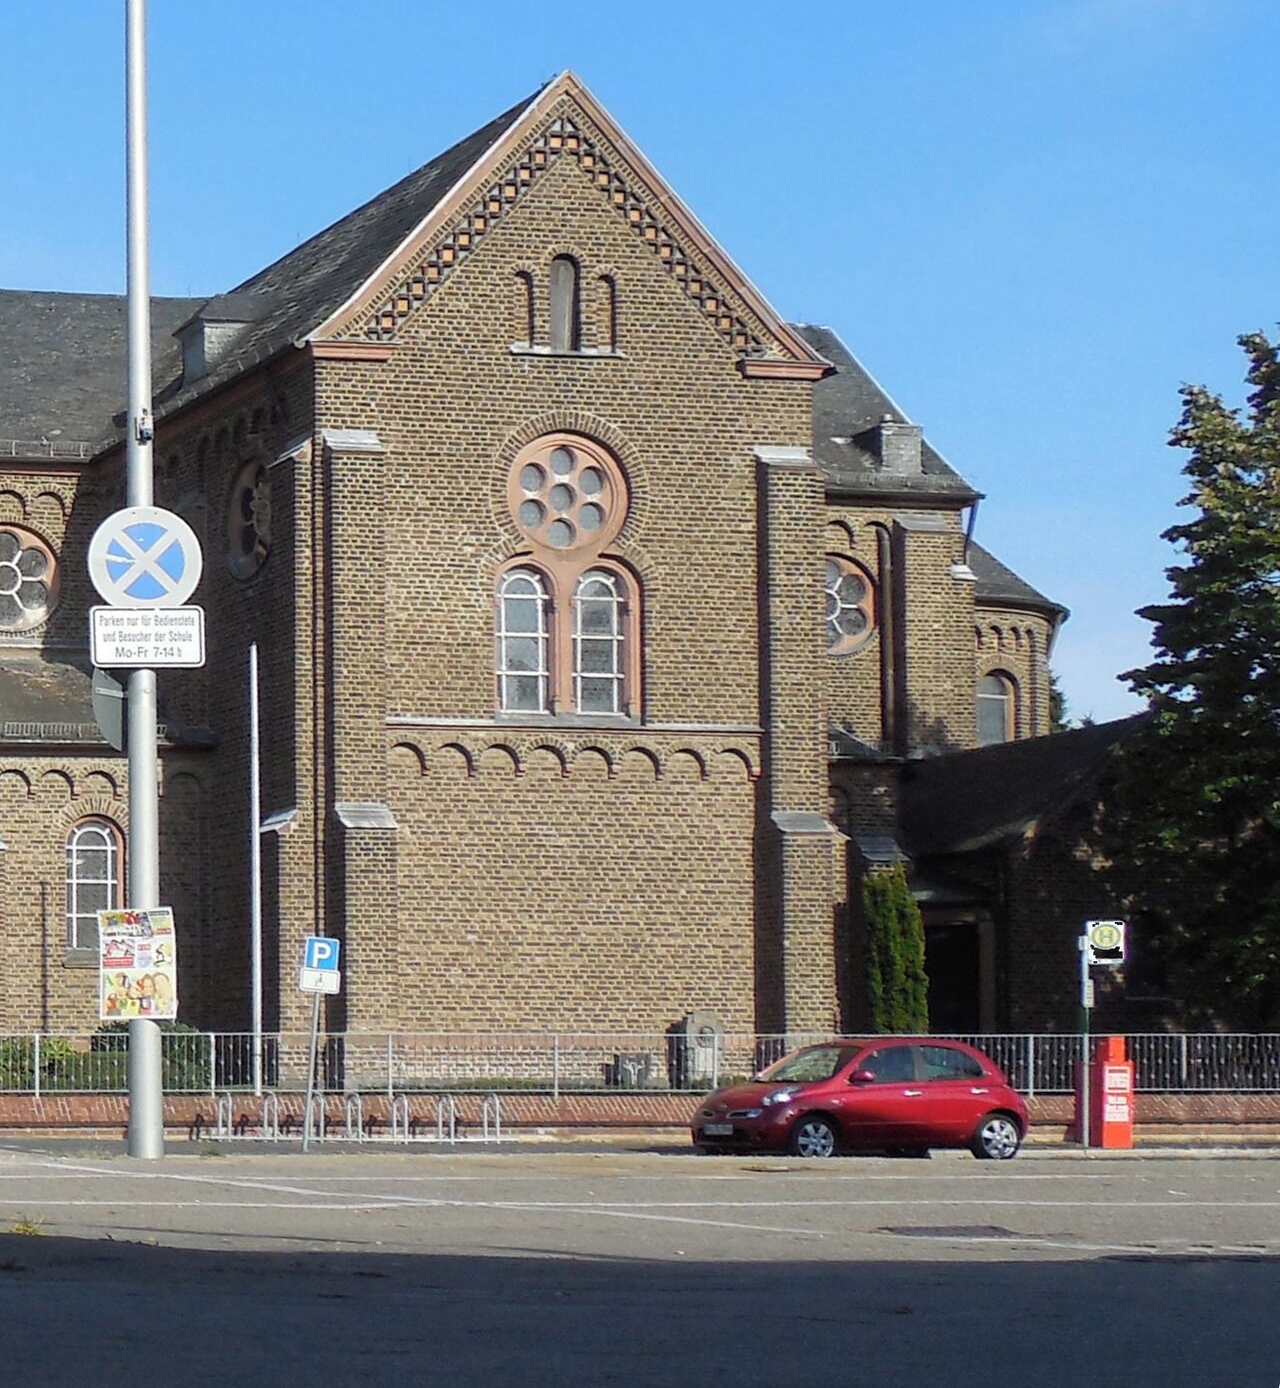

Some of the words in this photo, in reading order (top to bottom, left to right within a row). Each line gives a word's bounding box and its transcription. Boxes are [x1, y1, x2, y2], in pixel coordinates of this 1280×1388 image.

[99, 615, 124, 626] Parken
[127, 617, 139, 626] nur
[141, 615, 152, 626] für
[154, 615, 194, 626] Bedienstete
[102, 631, 116, 642] und
[118, 631, 152, 642] Besucher
[154, 631, 166, 642] der
[169, 631, 192, 642] Schule
[115, 646, 148, 658] Mo-Fr
[153, 646, 175, 658] 7-14
[1100, 929, 1113, 944] H
[312, 942, 331, 967] P
